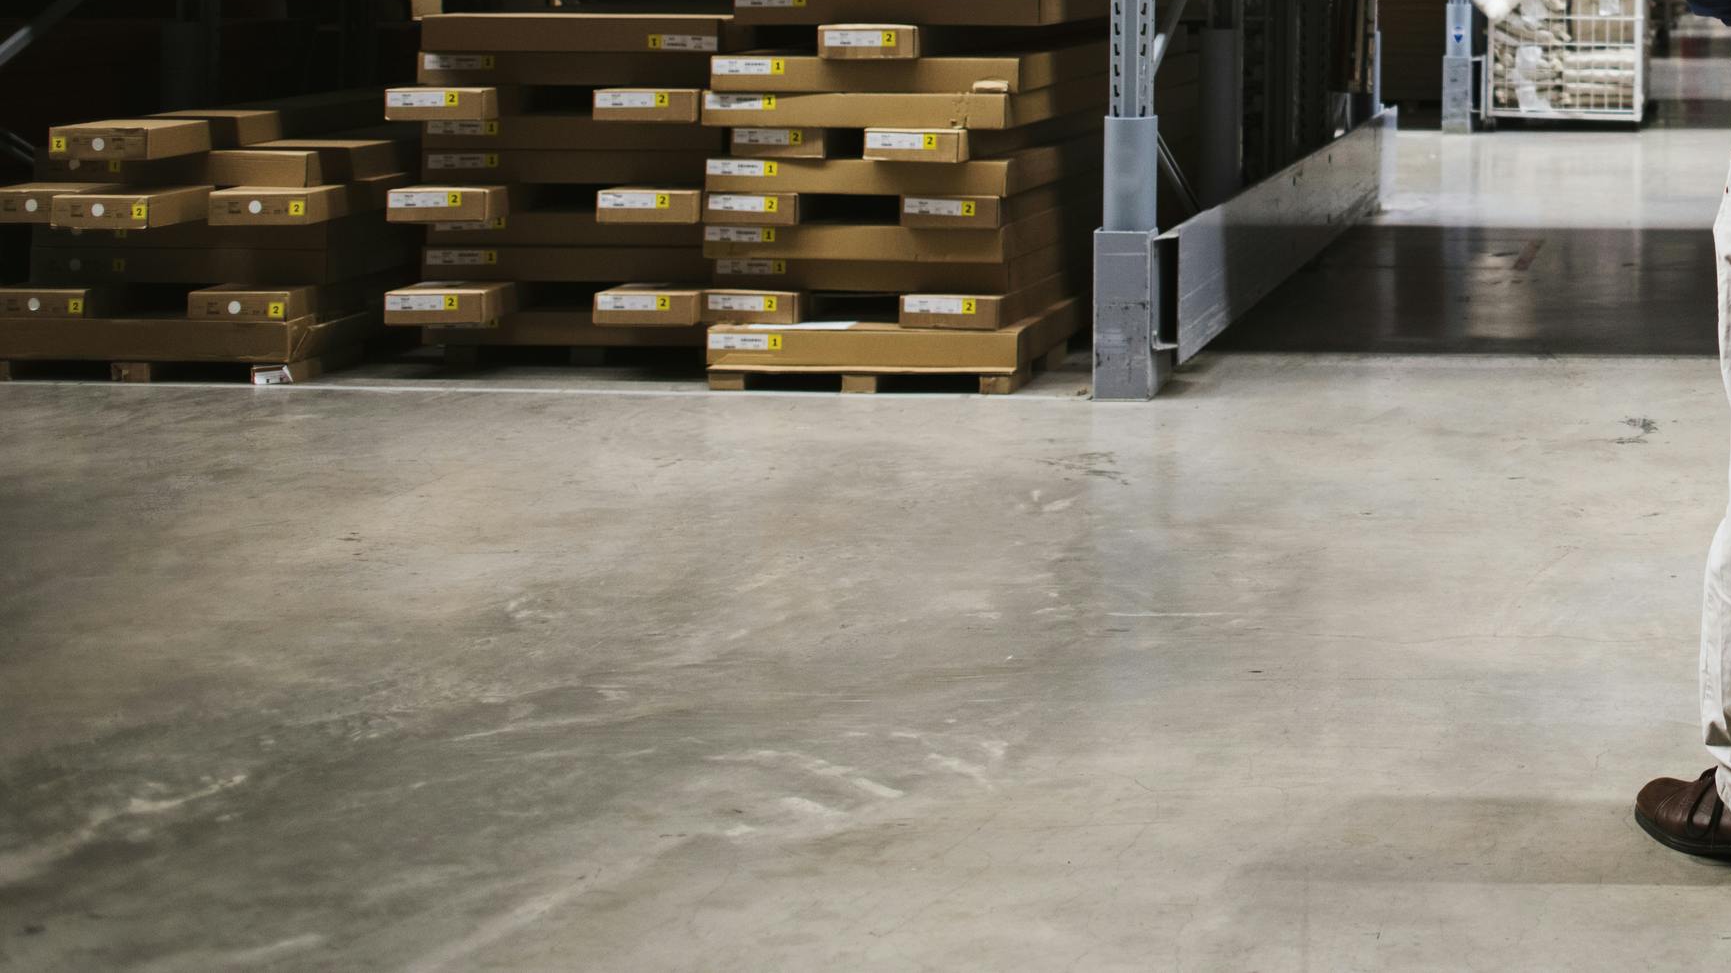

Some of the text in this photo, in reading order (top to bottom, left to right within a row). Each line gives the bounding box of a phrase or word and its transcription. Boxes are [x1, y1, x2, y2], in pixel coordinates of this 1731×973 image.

[886, 33, 892, 42] 2
[776, 62, 780, 70] 1
[449, 94, 455, 103] 2
[659, 94, 665, 104] 2
[767, 97, 772, 105] 1
[793, 132, 799, 142] 2
[927, 136, 933, 145] 2
[768, 165, 773, 173] 1
[451, 194, 458, 203] 2
[660, 196, 666, 205] 2
[294, 204, 300, 213] 2
[768, 200, 774, 209] 2
[965, 204, 972, 213] 2
[136, 208, 142, 216] 2
[766, 230, 771, 240] 1
[777, 263, 782, 272] 1
[73, 302, 79, 311] 2
[448, 297, 454, 307] 2
[660, 298, 666, 307] 2
[767, 299, 773, 309] 2
[966, 302, 972, 311] 2
[273, 306, 279, 314] 2
[773, 338, 777, 346] 1
